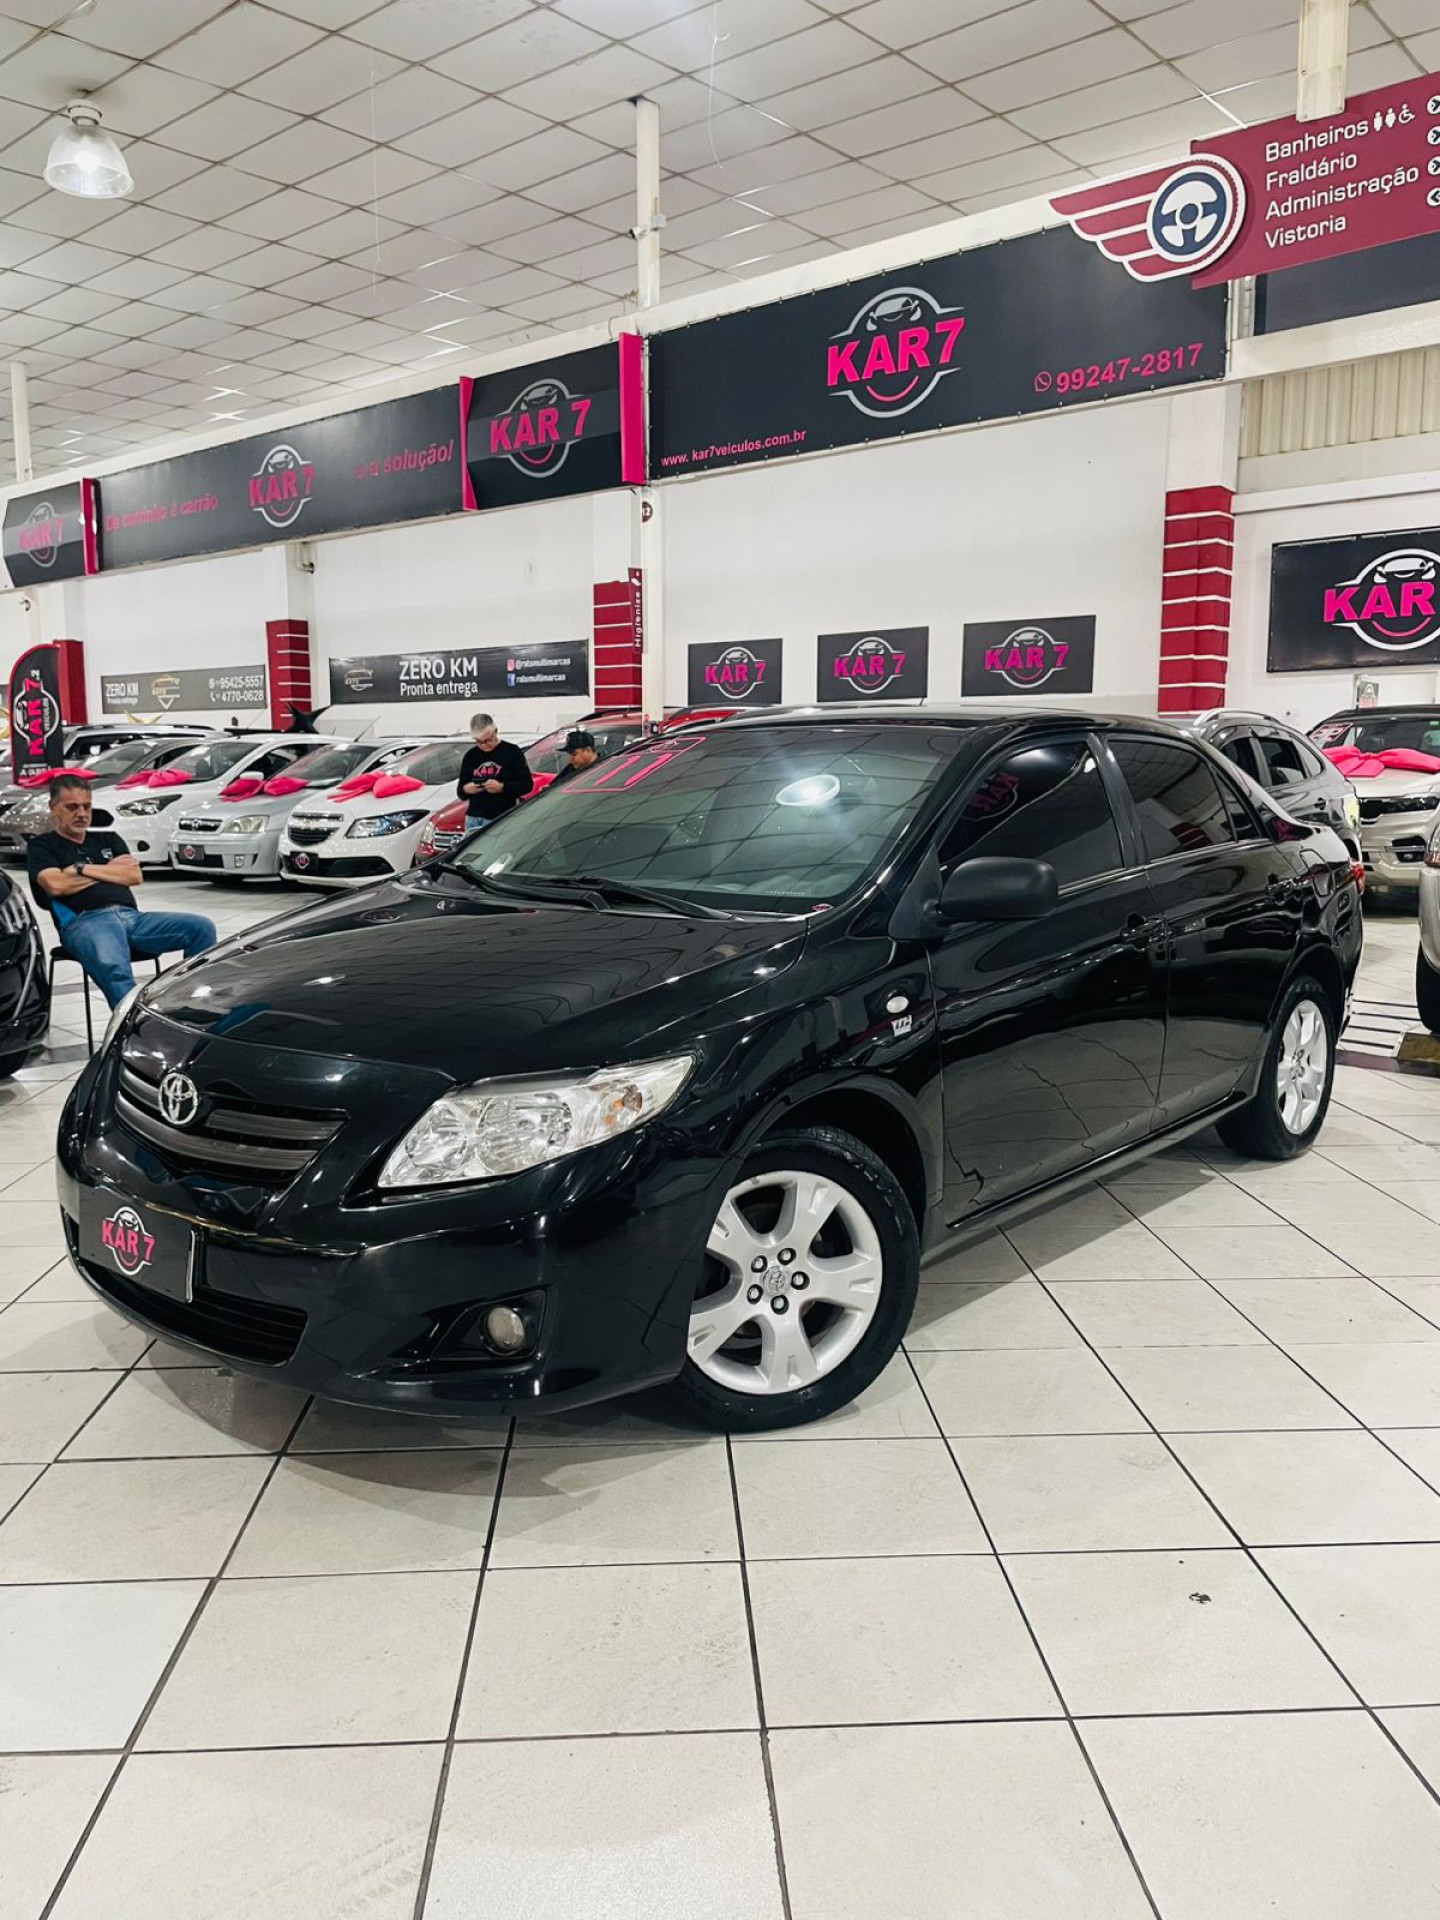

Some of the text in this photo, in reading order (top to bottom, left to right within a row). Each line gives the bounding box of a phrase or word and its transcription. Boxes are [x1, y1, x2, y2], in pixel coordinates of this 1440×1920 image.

[1265, 120, 1369, 162] Banheiros
[1266, 152, 1357, 191] Fraldário
[1265, 166, 1419, 221] Administração
[1264, 214, 1346, 249] Vistoria
[1056, 342, 1204, 394] 99247-2817
[490, 398, 592, 454] KAR 7
[384, 439, 454, 473] solução!
[692, 429, 807, 462] kar7veiculos.com.br
[249, 465, 316, 507] KAR 7
[634, 591, 643, 648] Higienize
[1324, 581, 1435, 622] KAR
[399, 656, 478, 681] ZERO KM
[705, 661, 767, 684] KAR 7
[834, 653, 907, 678] KAR 7
[985, 645, 1070, 670] KAR 7
[105, 682, 126, 697] ZERO
[126, 681, 139, 696] KM
[400, 681, 478, 698] Pronta entrega
[102, 1219, 155, 1261] KAR 7
